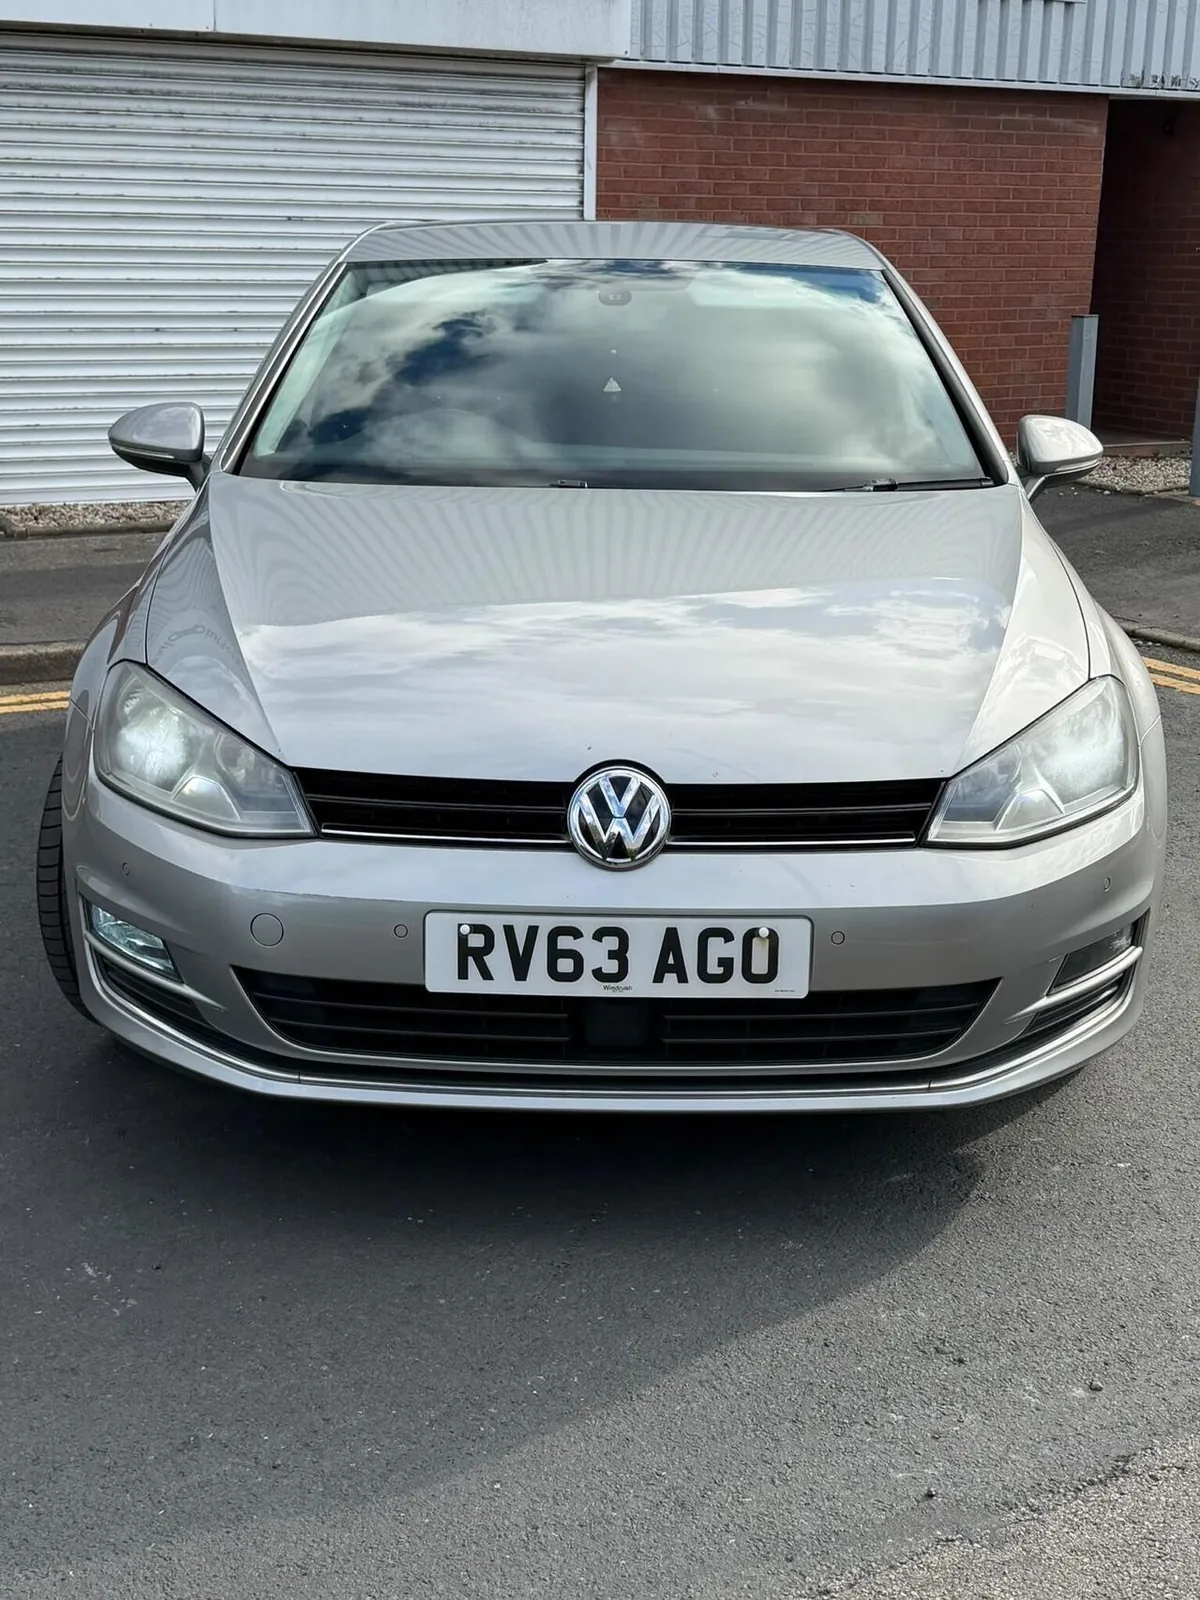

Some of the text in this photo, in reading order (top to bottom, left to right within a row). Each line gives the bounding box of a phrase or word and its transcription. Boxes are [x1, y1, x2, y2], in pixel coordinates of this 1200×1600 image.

[572, 770, 666, 864] VW
[457, 923, 780, 984] RV63 AGO
